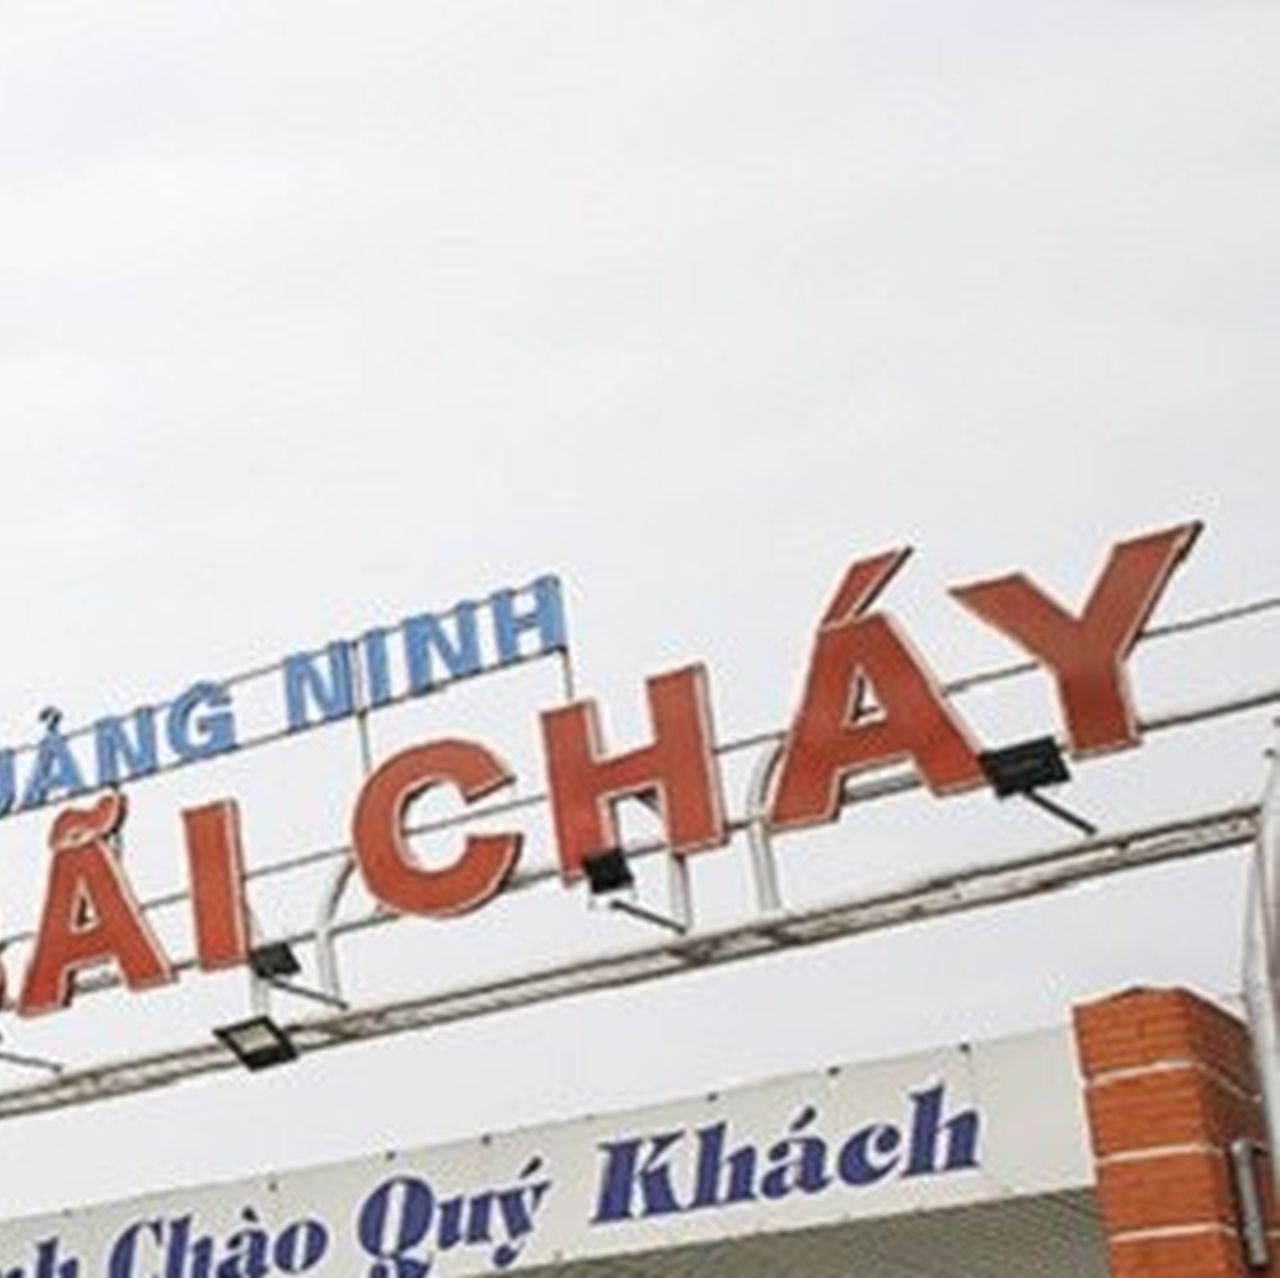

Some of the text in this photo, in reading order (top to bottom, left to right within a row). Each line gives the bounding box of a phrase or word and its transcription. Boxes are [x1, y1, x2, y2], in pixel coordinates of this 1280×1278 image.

[282, 574, 567, 734] NINH
[352, 521, 1204, 919] CHÁY
[590, 1084, 984, 1225] Khách
